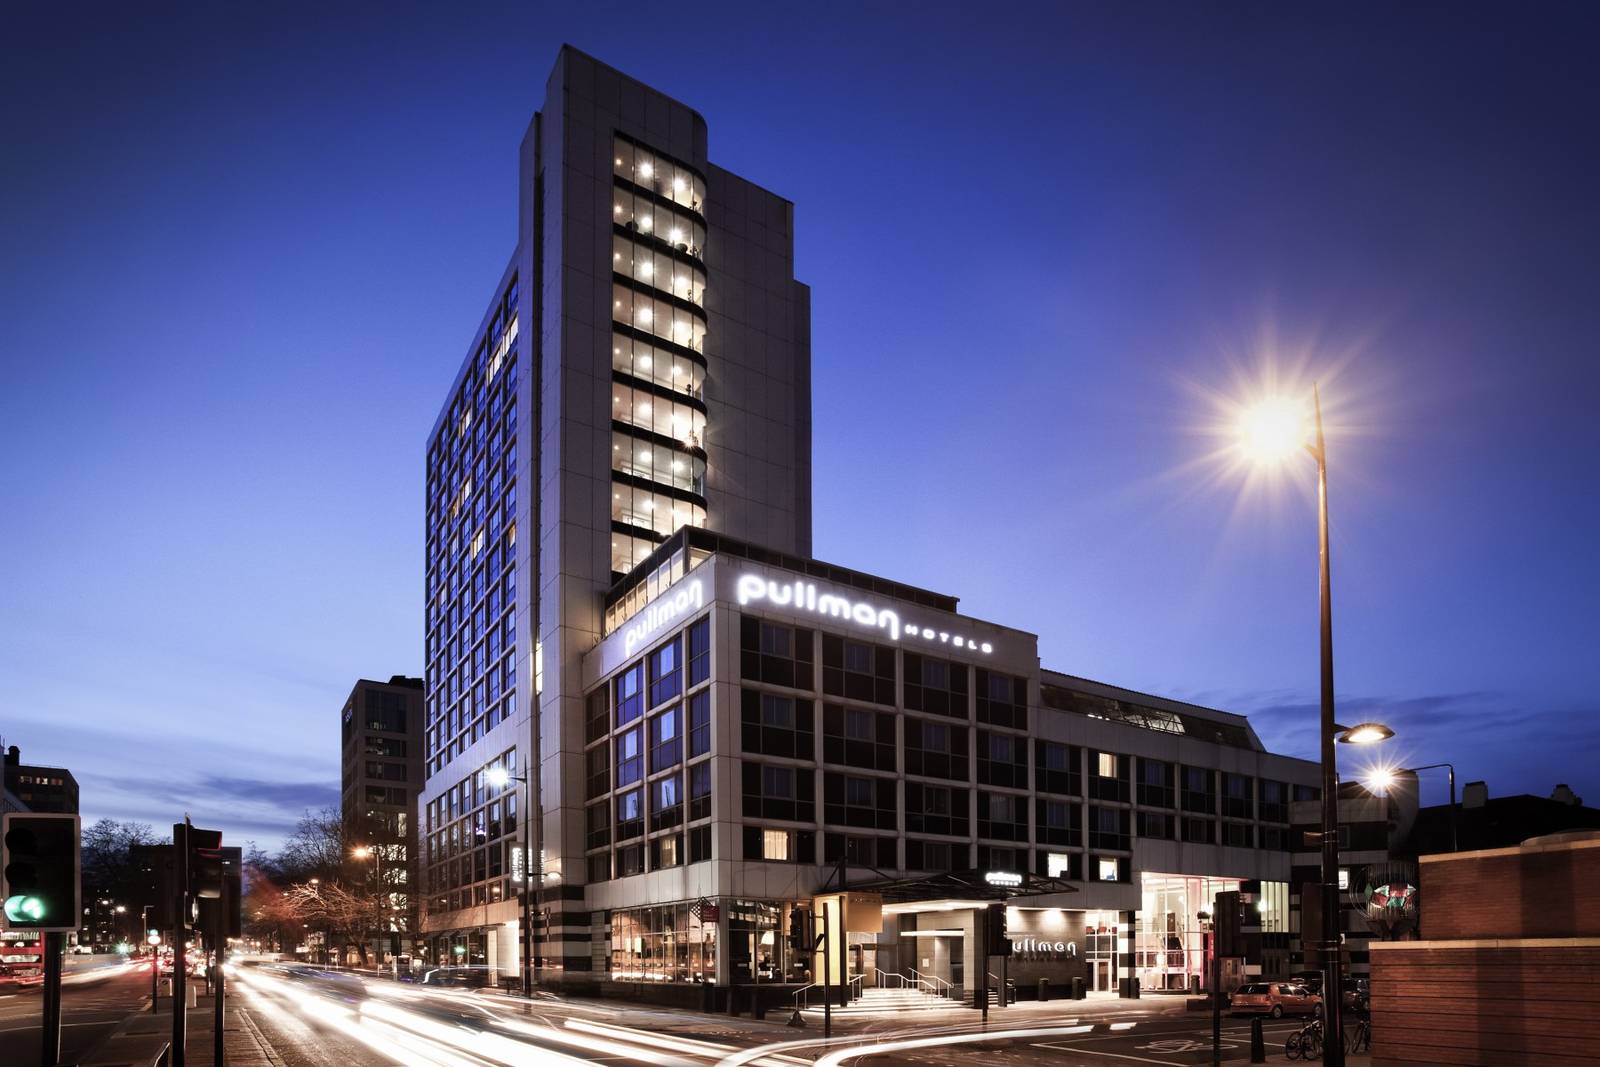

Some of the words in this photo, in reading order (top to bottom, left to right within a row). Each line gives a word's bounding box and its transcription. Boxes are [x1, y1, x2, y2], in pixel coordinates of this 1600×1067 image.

[624, 579, 703, 658] pullman
[738, 574, 899, 640] pullman
[904, 624, 993, 654] HOTELS
[1012, 938, 1077, 956] ullman
